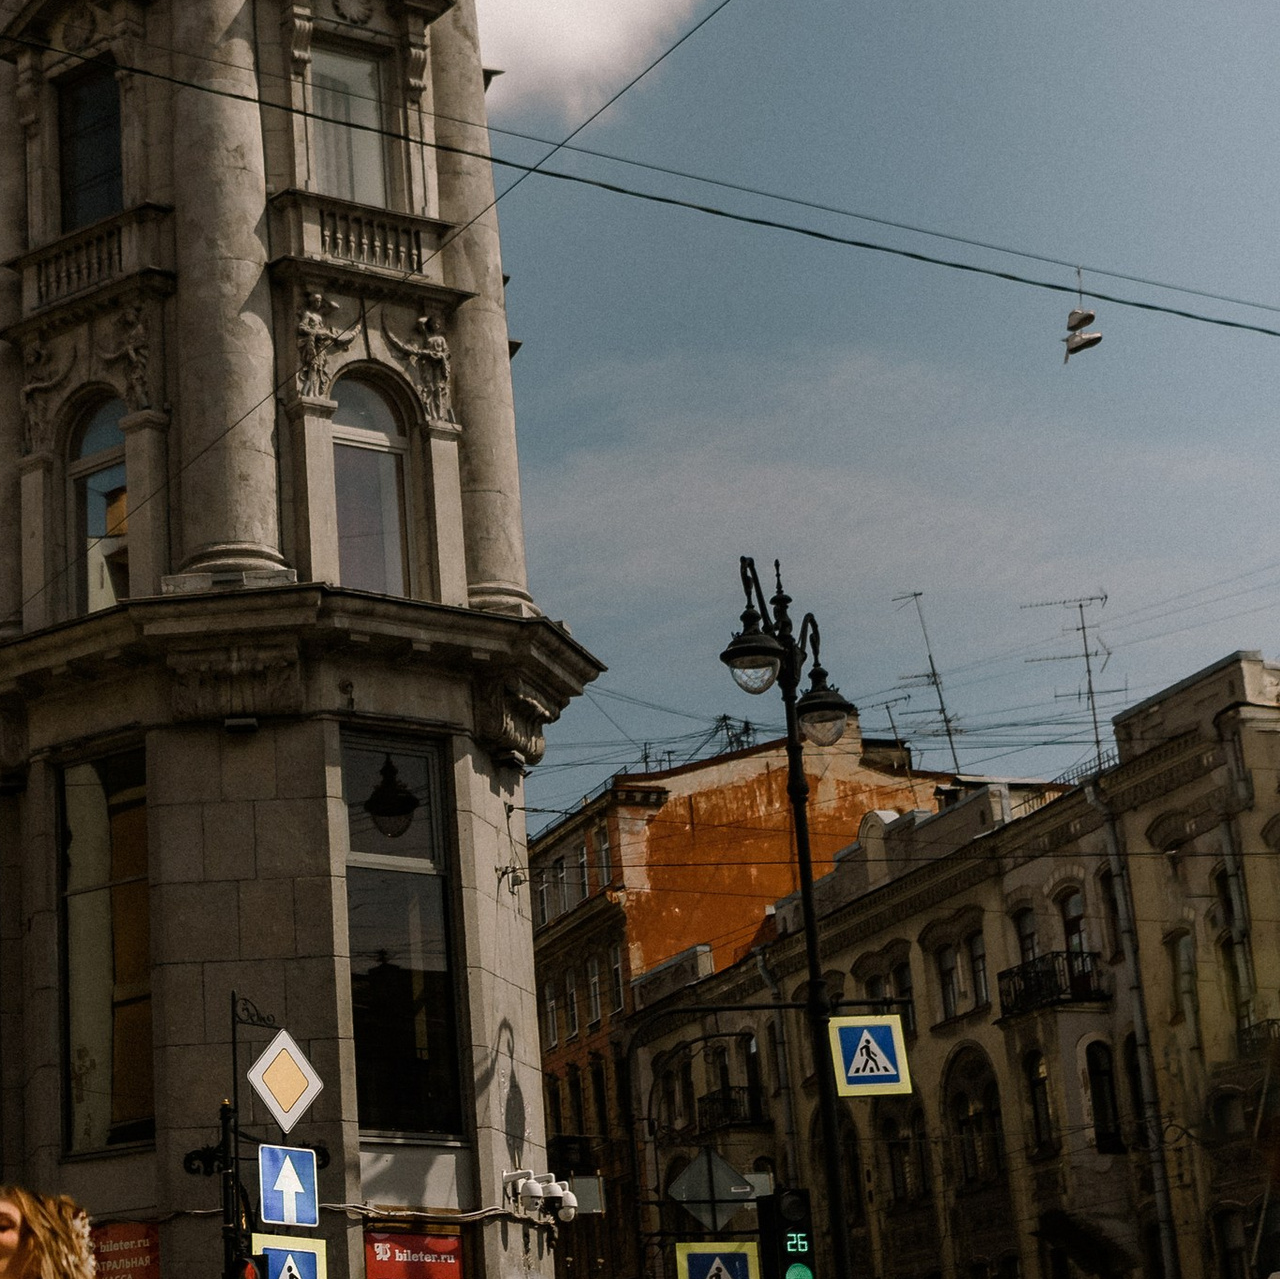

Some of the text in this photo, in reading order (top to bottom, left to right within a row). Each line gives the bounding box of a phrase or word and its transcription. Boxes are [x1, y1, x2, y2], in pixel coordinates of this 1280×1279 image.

[100, 1238, 149, 1253] bileter.ru
[787, 1233, 808, 1252] 26
[395, 1249, 455, 1264] bileter.ru
